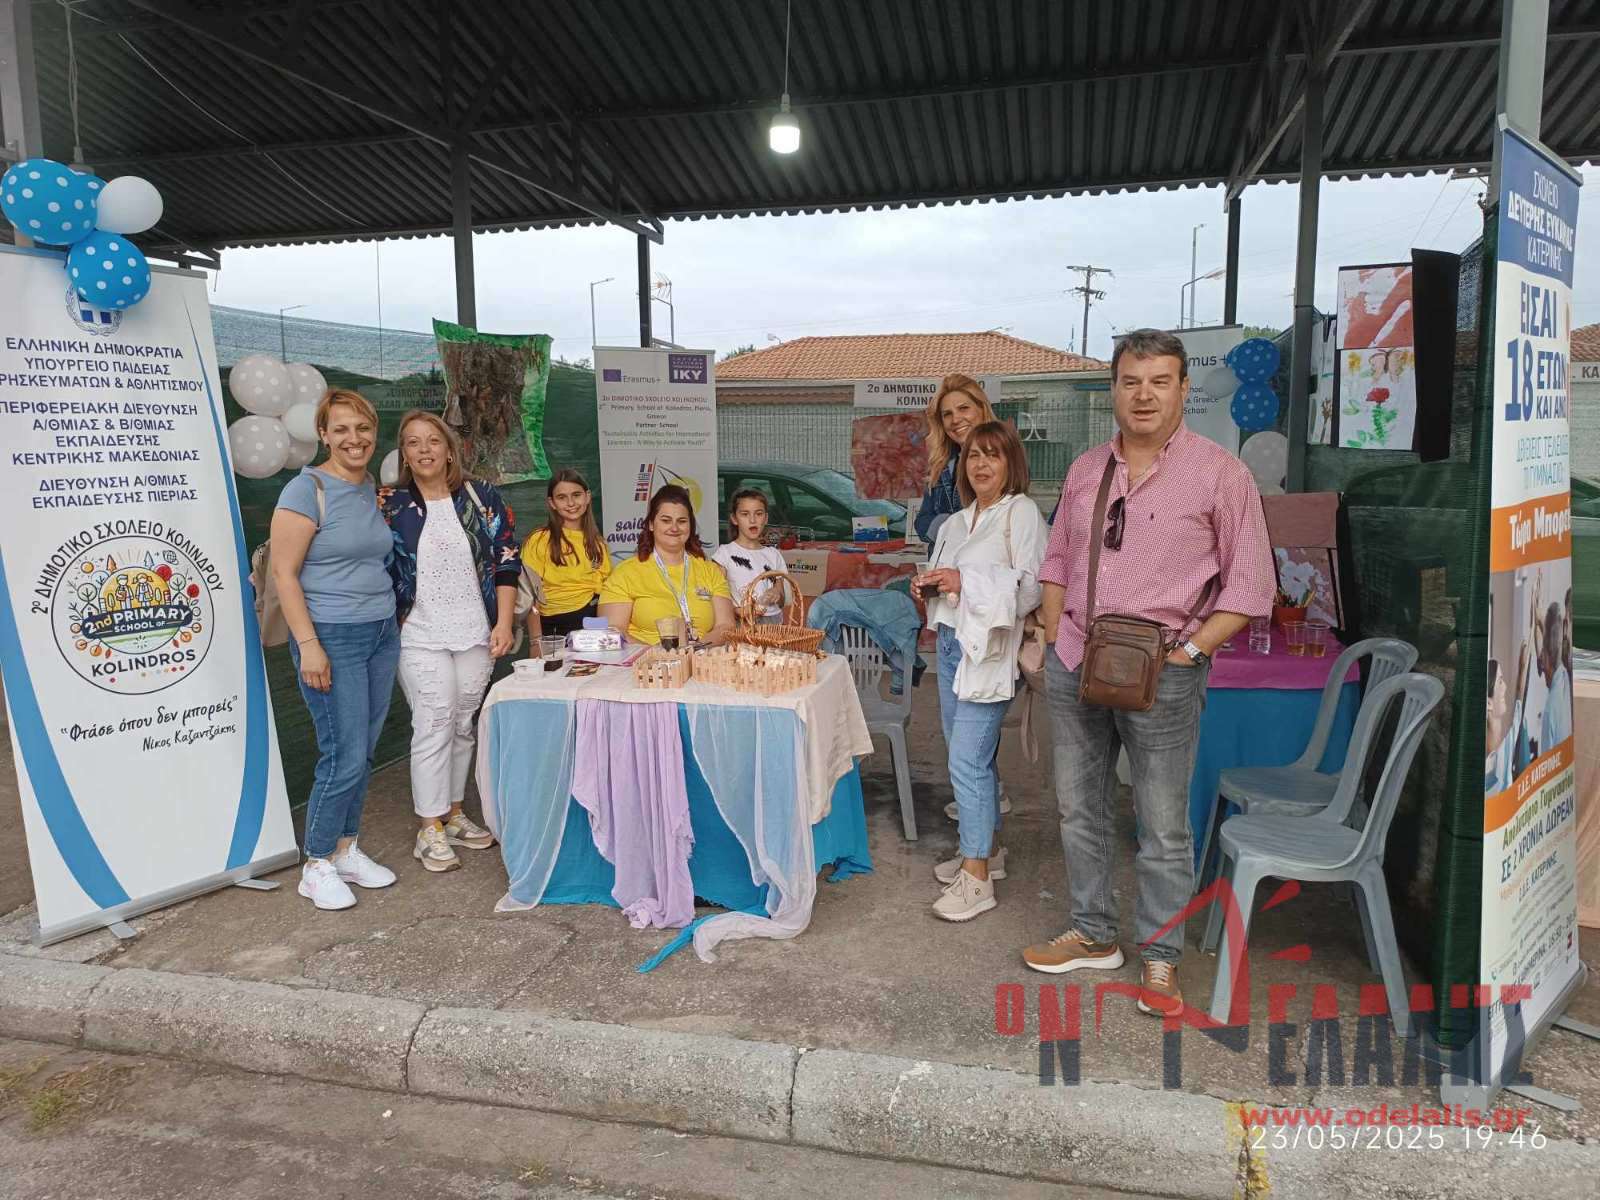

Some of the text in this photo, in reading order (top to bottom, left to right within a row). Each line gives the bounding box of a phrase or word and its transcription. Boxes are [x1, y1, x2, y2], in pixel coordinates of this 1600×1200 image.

[1533, 170, 1559, 210] ΣΧΟΛΕΙΟ
[1507, 190, 1545, 236] ΔΕΥΤΕΡΗΣ
[1527, 234, 1562, 272] ΚΑΤΕΡΙΝΗΣ
[1520, 280, 1557, 339] ΕΙΣΑΙ
[5, 336, 184, 360] ΕΛΛΗΝΙΚΗ ΔΗΜΟΚΡΑΤΙΑ
[24, 356, 172, 376] ΥΠΟΥΡΓΕΙΟ ΠΑΙΔΕΙΑΣ
[0, 373, 204, 393] ΡΗΣΚΕΥΜΑΤΩΝ & ΑΘΛΗΤΙΣΜΟΥ
[883, 383, 937, 394] ΔΗΜΟΤΙΚΟ
[1505, 337, 1567, 422] 18 ΕΤΩΝ
[0, 400, 198, 416] ΠΕΡΙΦΕΡΕΙΑΚΗ ΔΙΕΥΘΥΝΣΗ
[1536, 395, 1552, 419] ΚΑΙ
[32, 418, 175, 431] Α/ΘΜΙΑΣ & Β/ΘΜΙΑΣ
[55, 434, 161, 448] ΕΚΠΑΙΔΕΥΣΗΣ
[12, 449, 201, 466] ΚΕΝΤΡΙΚΗΣ ΜΑΚΕΔΟΝΙΑΣ
[39, 474, 189, 492] ΔΙΕΥΘΥΝΣΗ Α/ΘΜΙΑΣ
[32, 489, 199, 509] ΕΚΠΑΙΔΕΥΣΗΣ ΠΙΕΡΙΑΣ
[1509, 497, 1570, 555] Τώρα Μπορεί
[37, 530, 94, 599] ΔΗΜΟΤΙΚΟ
[96, 518, 164, 540] ΣΧΟΛΕΙΟ
[165, 527, 225, 593] ΚΟΛΙΝΔΡΟΥ
[84, 607, 191, 634] 2nd PRIMARY
[114, 621, 155, 633] SCHOOL
[91, 649, 197, 677] KOLINDROS
[119, 717, 153, 733] όπου
[157, 705, 178, 725] δεν
[142, 722, 237, 752] Νίκος Καζαντζάκης
[1501, 855, 1512, 883] ΣΕ
[1518, 820, 1544, 863] ΧΡΟΝΙΑ
[1545, 792, 1574, 835] ΔΩΡΕΑΝ
